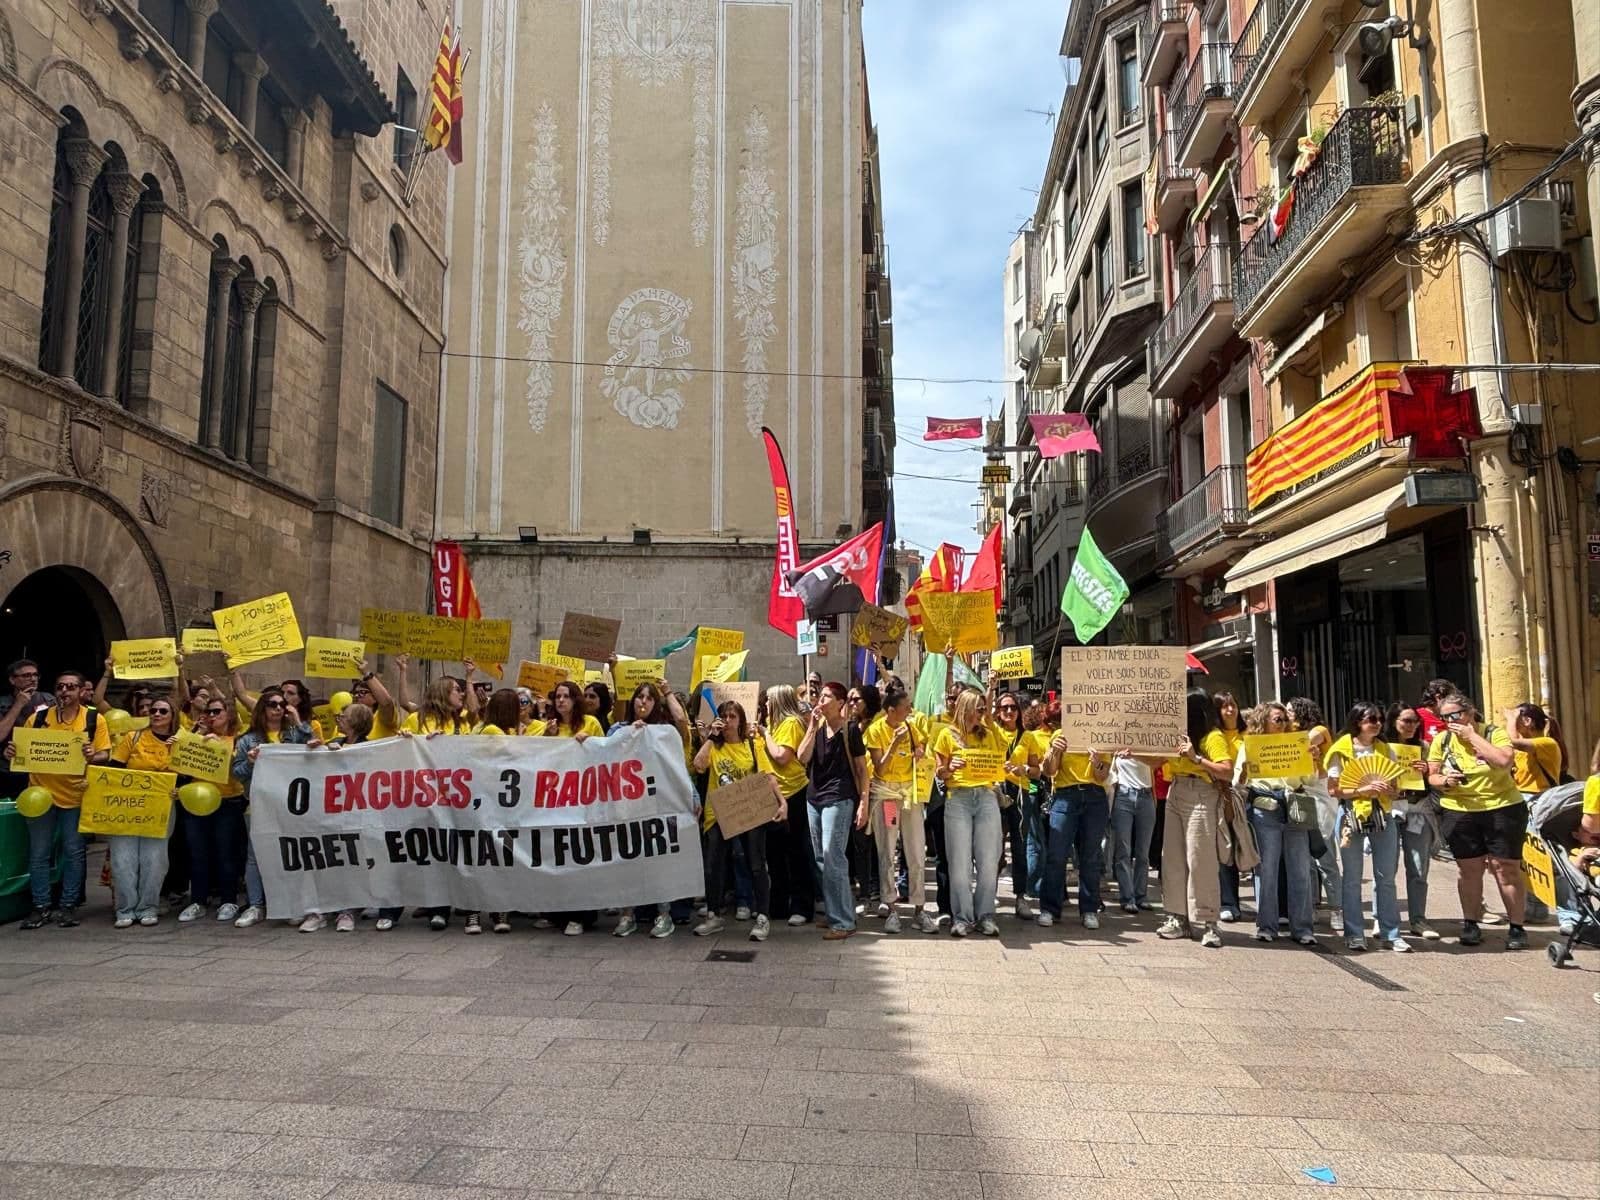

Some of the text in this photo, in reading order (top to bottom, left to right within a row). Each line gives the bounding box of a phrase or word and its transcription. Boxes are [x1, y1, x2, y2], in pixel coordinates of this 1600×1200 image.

[437, 551, 454, 617] UGT
[1071, 651, 1083, 662] EL
[997, 670, 1029, 679] MPORTA
[1086, 666, 1171, 680] VOLEM SOUS DIGNES
[1085, 701, 1099, 713] NO
[1103, 700, 1120, 713] PER
[1090, 731, 1134, 745] DOCENTS
[97, 771, 110, 785] A
[288, 759, 657, 816] 0 EXCUSES, 3 RAONS:
[104, 794, 148, 808] TAMBÉ
[279, 815, 680, 873] DRET, EQUITAT I FUTUR!
